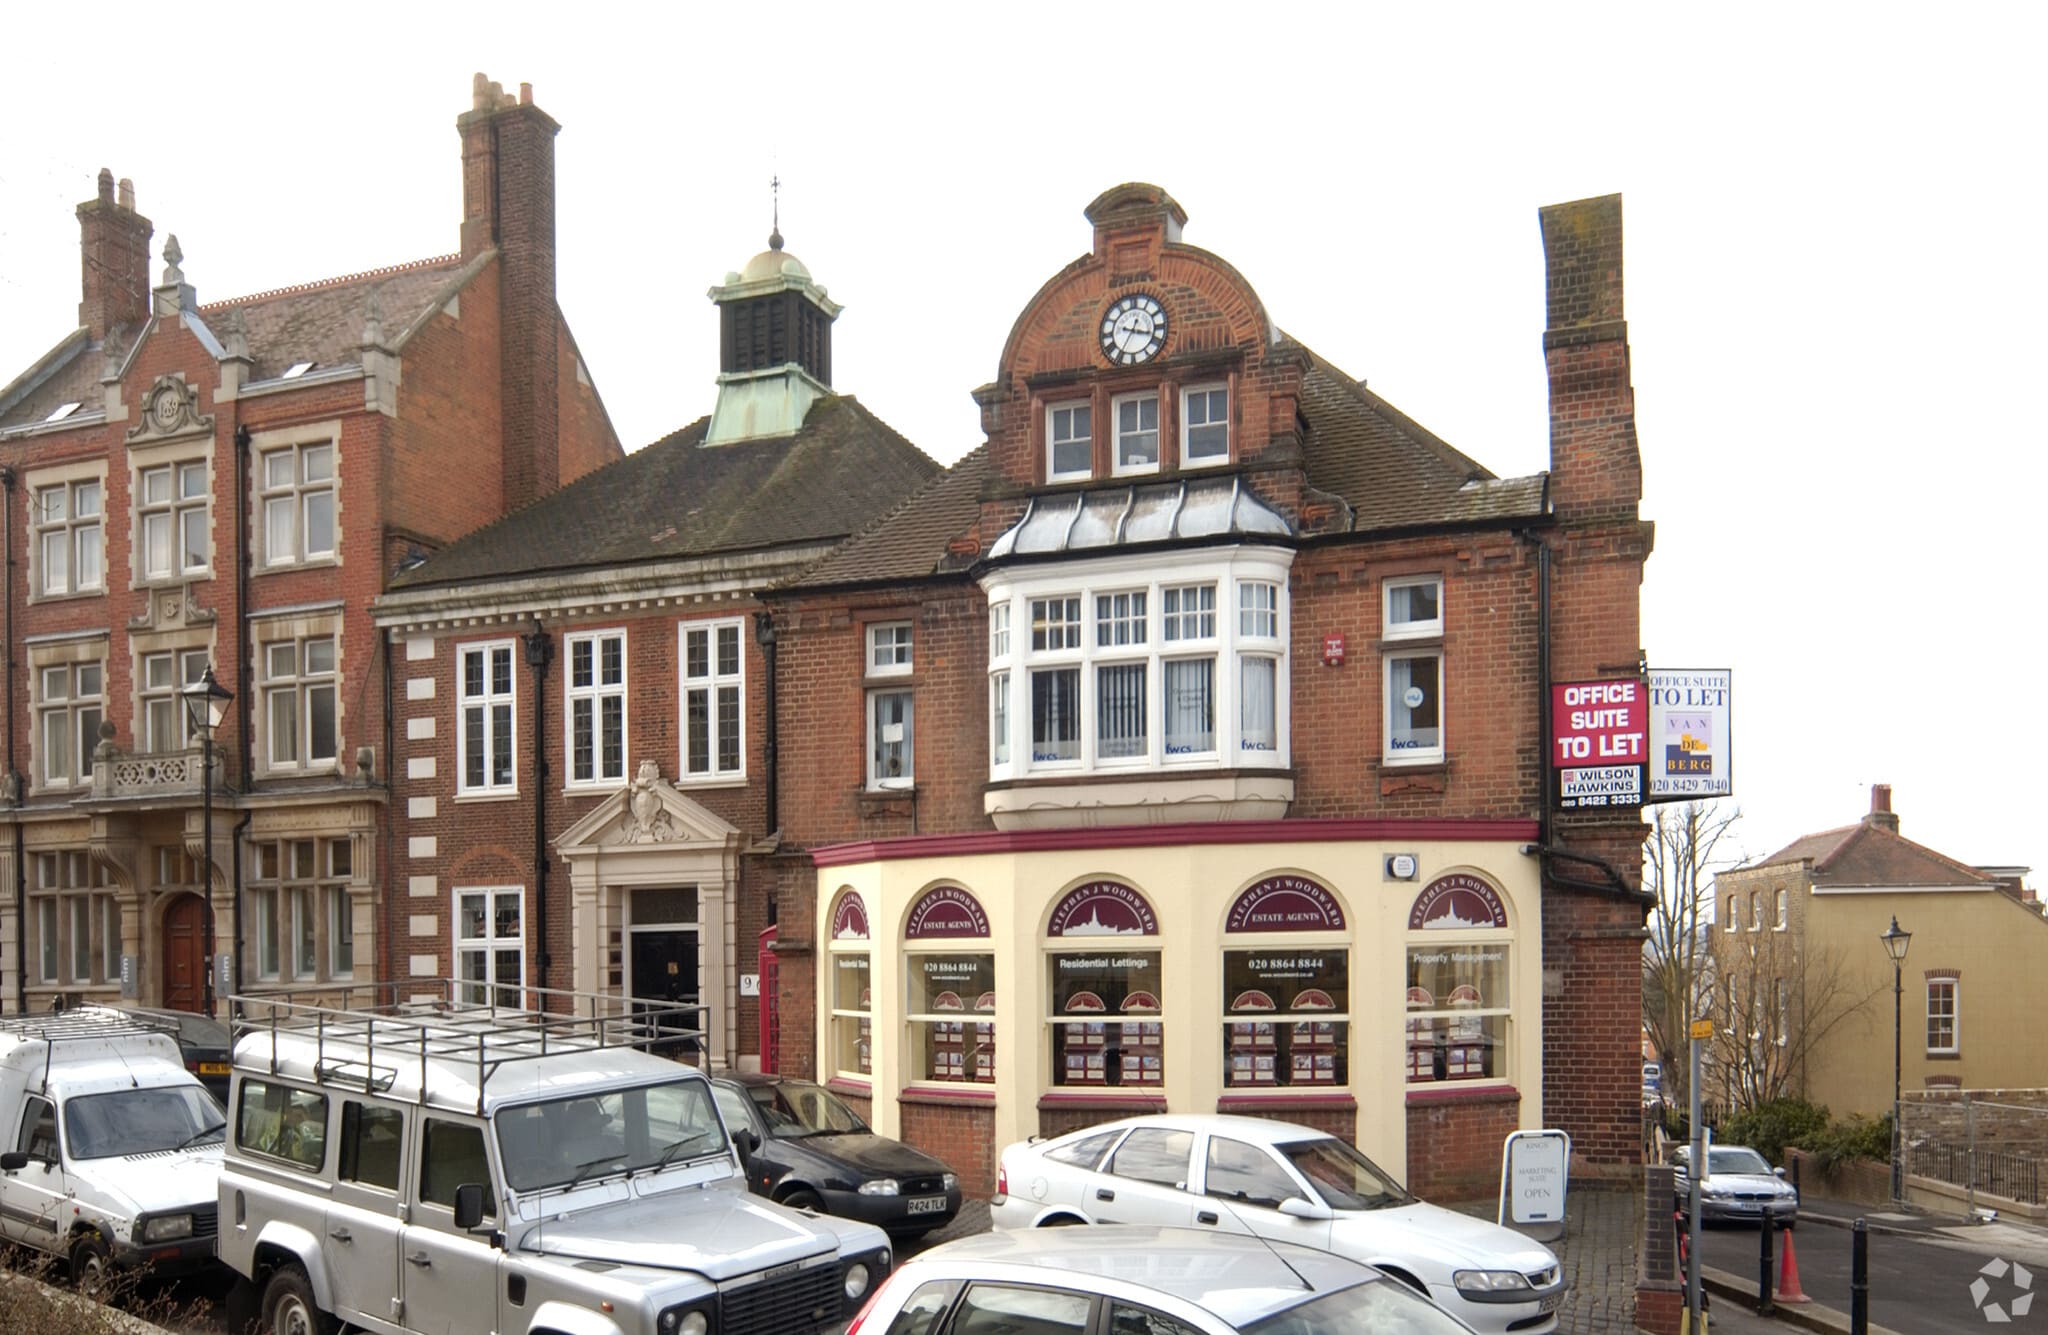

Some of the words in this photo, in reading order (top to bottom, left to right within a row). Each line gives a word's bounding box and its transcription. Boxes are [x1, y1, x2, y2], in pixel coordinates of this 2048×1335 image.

[1650, 676, 1691, 687] OFFICE
[1692, 676, 1727, 687] SUITE
[1564, 683, 1635, 706] OFFICE
[1650, 687, 1681, 706] TO
[1686, 688, 1727, 706] LET
[1571, 708, 1629, 730] SUITE
[1669, 719, 1707, 729] VAN
[1558, 735, 1590, 759] TO
[1599, 732, 1643, 757] LET
[1681, 739, 1700, 750] DE
[1667, 759, 1710, 770] BERG
[1579, 768, 1634, 781] WILSON
[1567, 780, 1633, 794] HAWKINS
[1650, 778, 1669, 792] 020
[1672, 778, 1698, 792] 8429
[1702, 778, 1727, 791] 7040
[1578, 795, 1607, 806] 8422
[1610, 794, 1640, 805] 3333
[1231, 883, 1272, 928] STEPHEN
[1275, 880, 1281, 889] J
[1285, 879, 1341, 926] WOODWARD
[1414, 880, 1448, 924] STEPHEN
[1450, 878, 1455, 887] J
[1458, 877, 1503, 923] WOODWARD
[909, 894, 937, 935] STEPHEN
[945, 890, 987, 933] WOODWARD
[1052, 888, 1090, 932] STEPHEN
[1093, 885, 1098, 894] J
[1102, 884, 1154, 930] WOODWARD
[1251, 913, 1285, 922] ESTATE
[1286, 912, 1320, 921] AGENTS
[923, 920, 946, 929] ESTATE
[947, 920, 972, 929] AGENTS
[1059, 959, 1108, 969] Residential
[1111, 958, 1148, 969] Lettings
[1248, 959, 1268, 969] 020
[1270, 959, 1295, 969] 8864
[1297, 958, 1323, 969] 8844
[1413, 953, 1448, 964] Property
[924, 962, 937, 972] 020
[1524, 1188, 1551, 1199] OPEN
